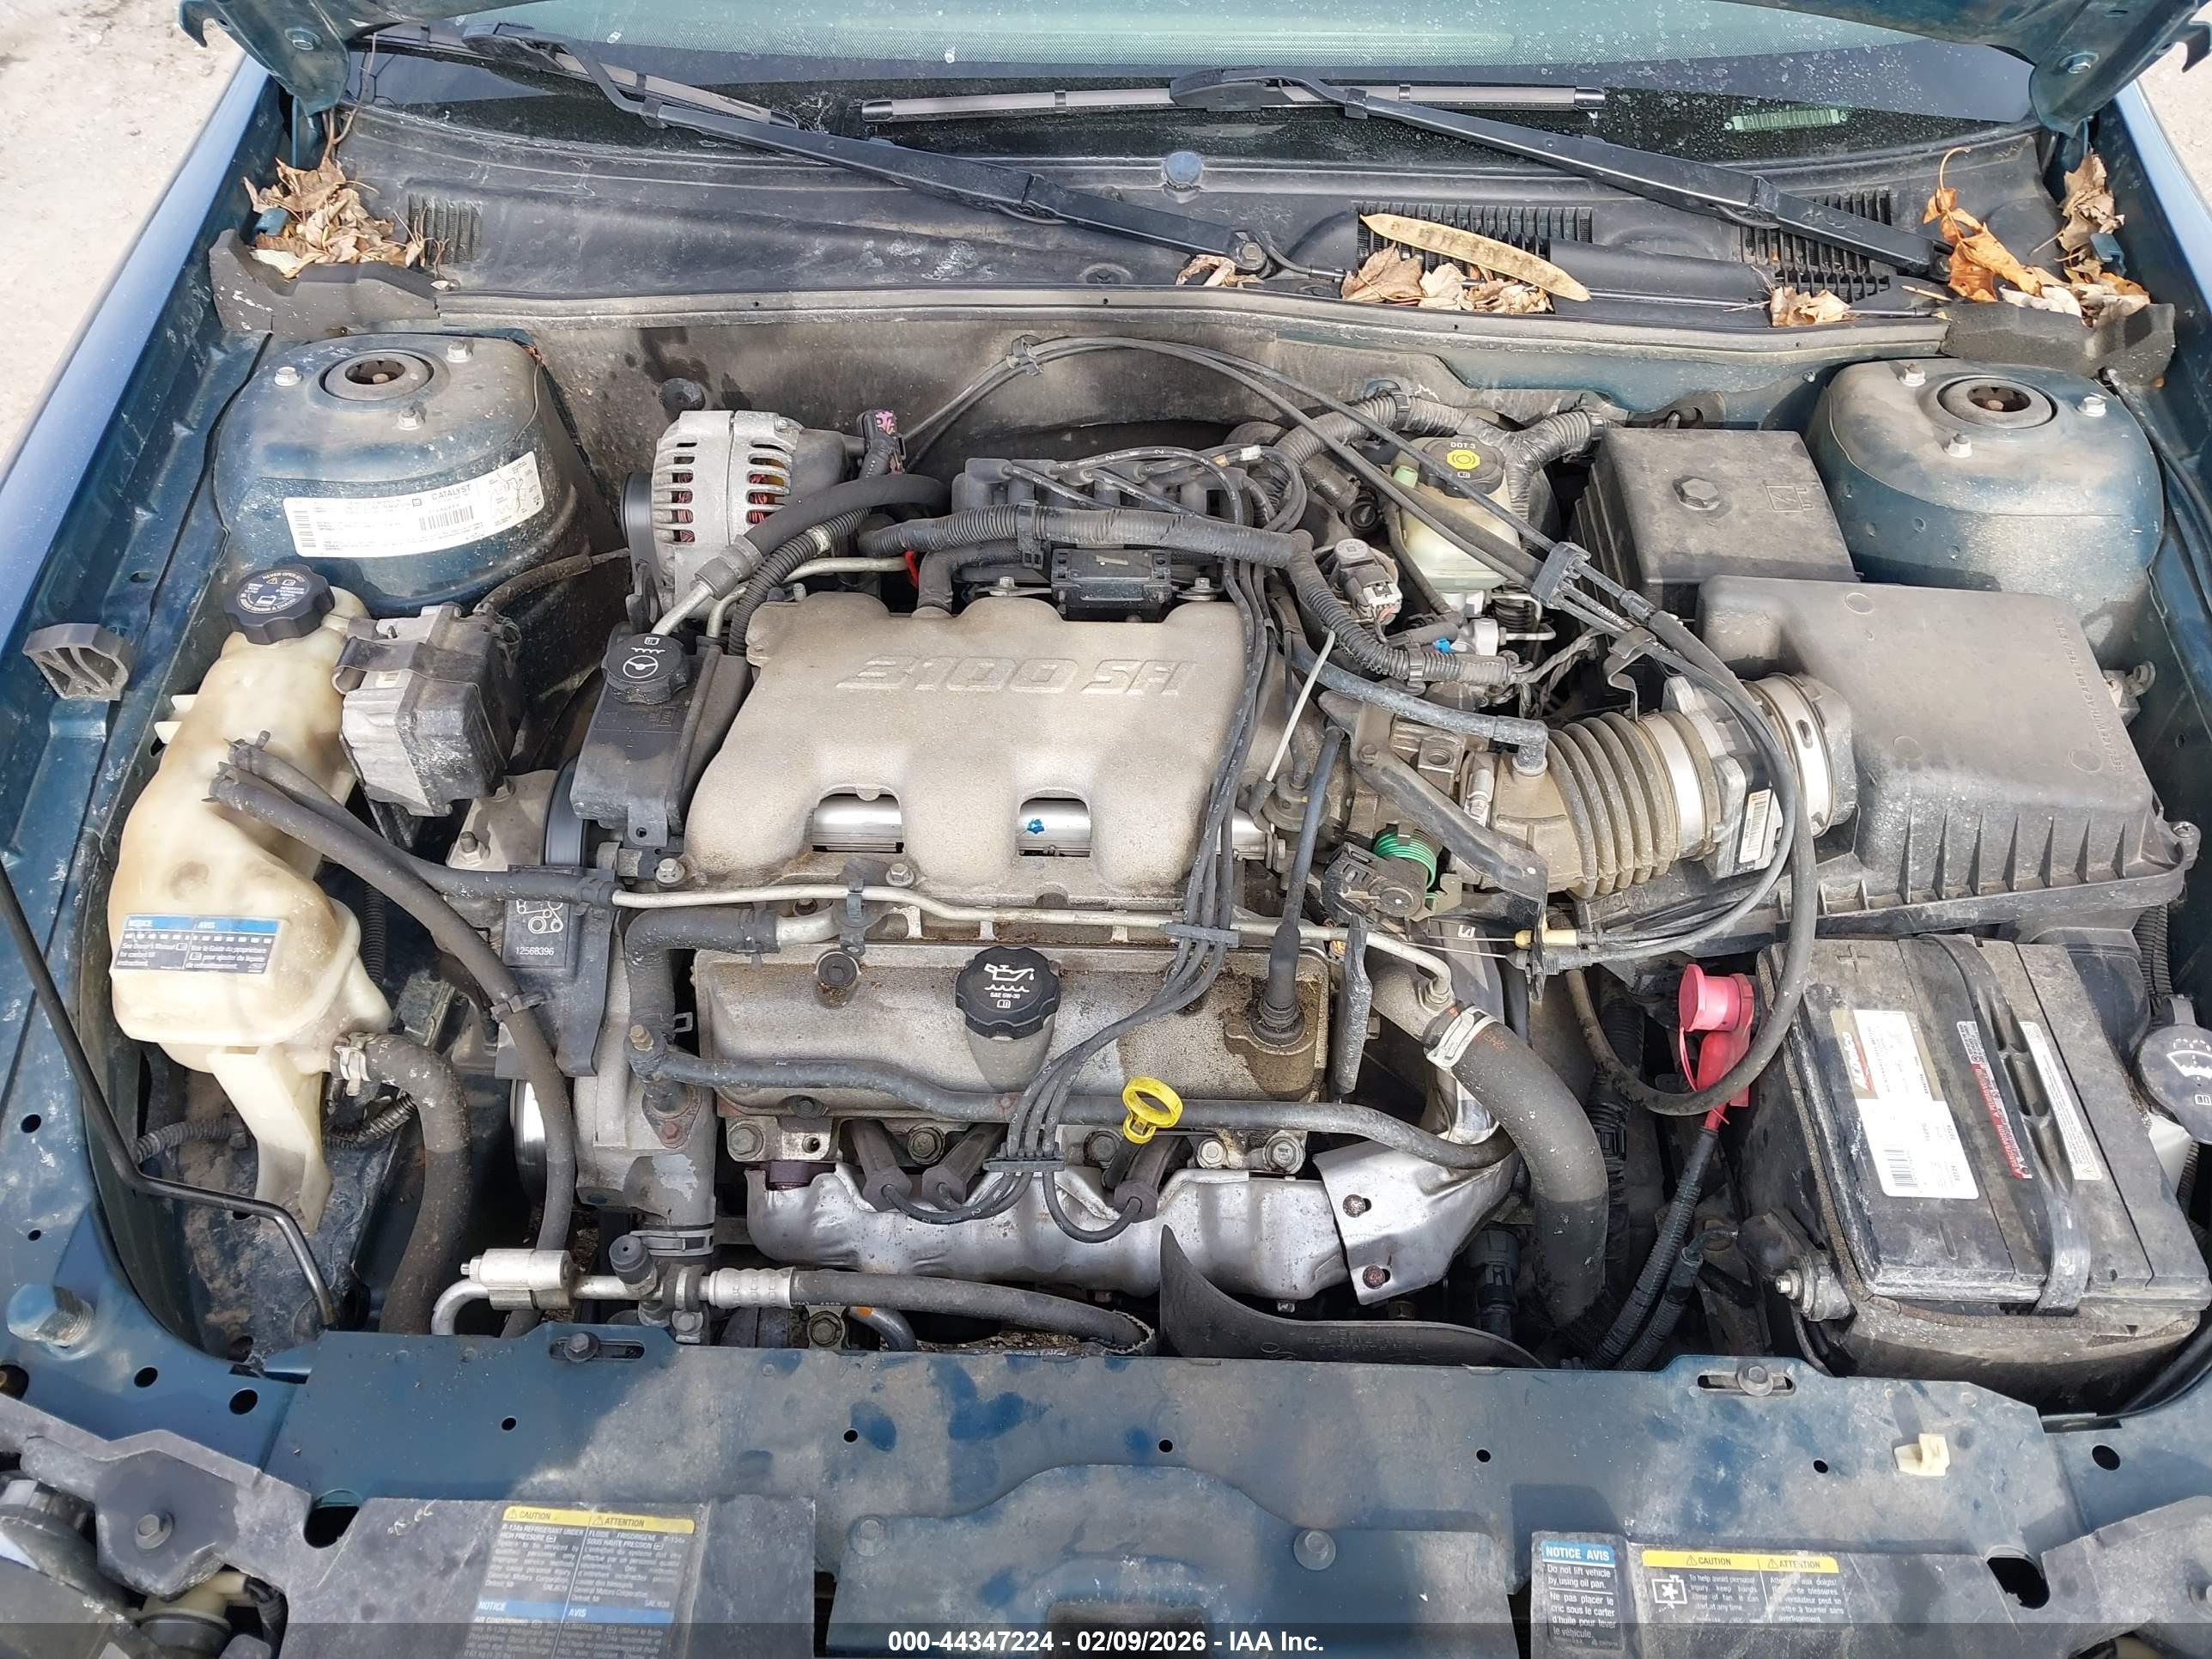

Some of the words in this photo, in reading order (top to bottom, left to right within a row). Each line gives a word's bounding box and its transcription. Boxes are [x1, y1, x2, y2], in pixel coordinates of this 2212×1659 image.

[431, 483, 471, 500] CATALYST
[836, 653, 1079, 692] 3100
[1080, 658, 1195, 696] SFI
[516, 946, 555, 956] 12568396
[519, 1511, 551, 1520] CAUTION
[605, 1517, 645, 1528] ATTENTION
[1546, 1546, 1581, 1559] NOTICE
[1586, 1548, 1610, 1562] AVIS
[1698, 1557, 1731, 1566] CAUTION
[1778, 1559, 1821, 1570] ATTENTION
[1547, 1565, 1558, 1573] Do
[1559, 1565, 1571, 1574] not
[1573, 1565, 1583, 1575] lift
[1585, 1568, 1611, 1577] vehicle
[1547, 1577, 1557, 1586] by
[1559, 1577, 1579, 1588] using
[1580, 1578, 1589, 1588] oil
[1590, 1581, 1607, 1589] pan.
[1550, 1591, 1560, 1601] Ne
[1564, 1594, 1577, 1603] pas
[1581, 1594, 1603, 1605] placer
[1607, 1596, 1614, 1606] le
[477, 1601, 507, 1612] NOTICE
[1551, 1603, 1565, 1613] cric
[1566, 1606, 1583, 1614] sous
[1585, 1606, 1592, 1615] le
[1594, 1607, 1615, 1617] carter
[568, 1608, 586, 1618] AVIS
[1553, 1615, 1577, 1626] d'huile
[1578, 1618, 1596, 1627] pour
[1598, 1619, 1616, 1629] lever
[1553, 1626, 1560, 1635] le
